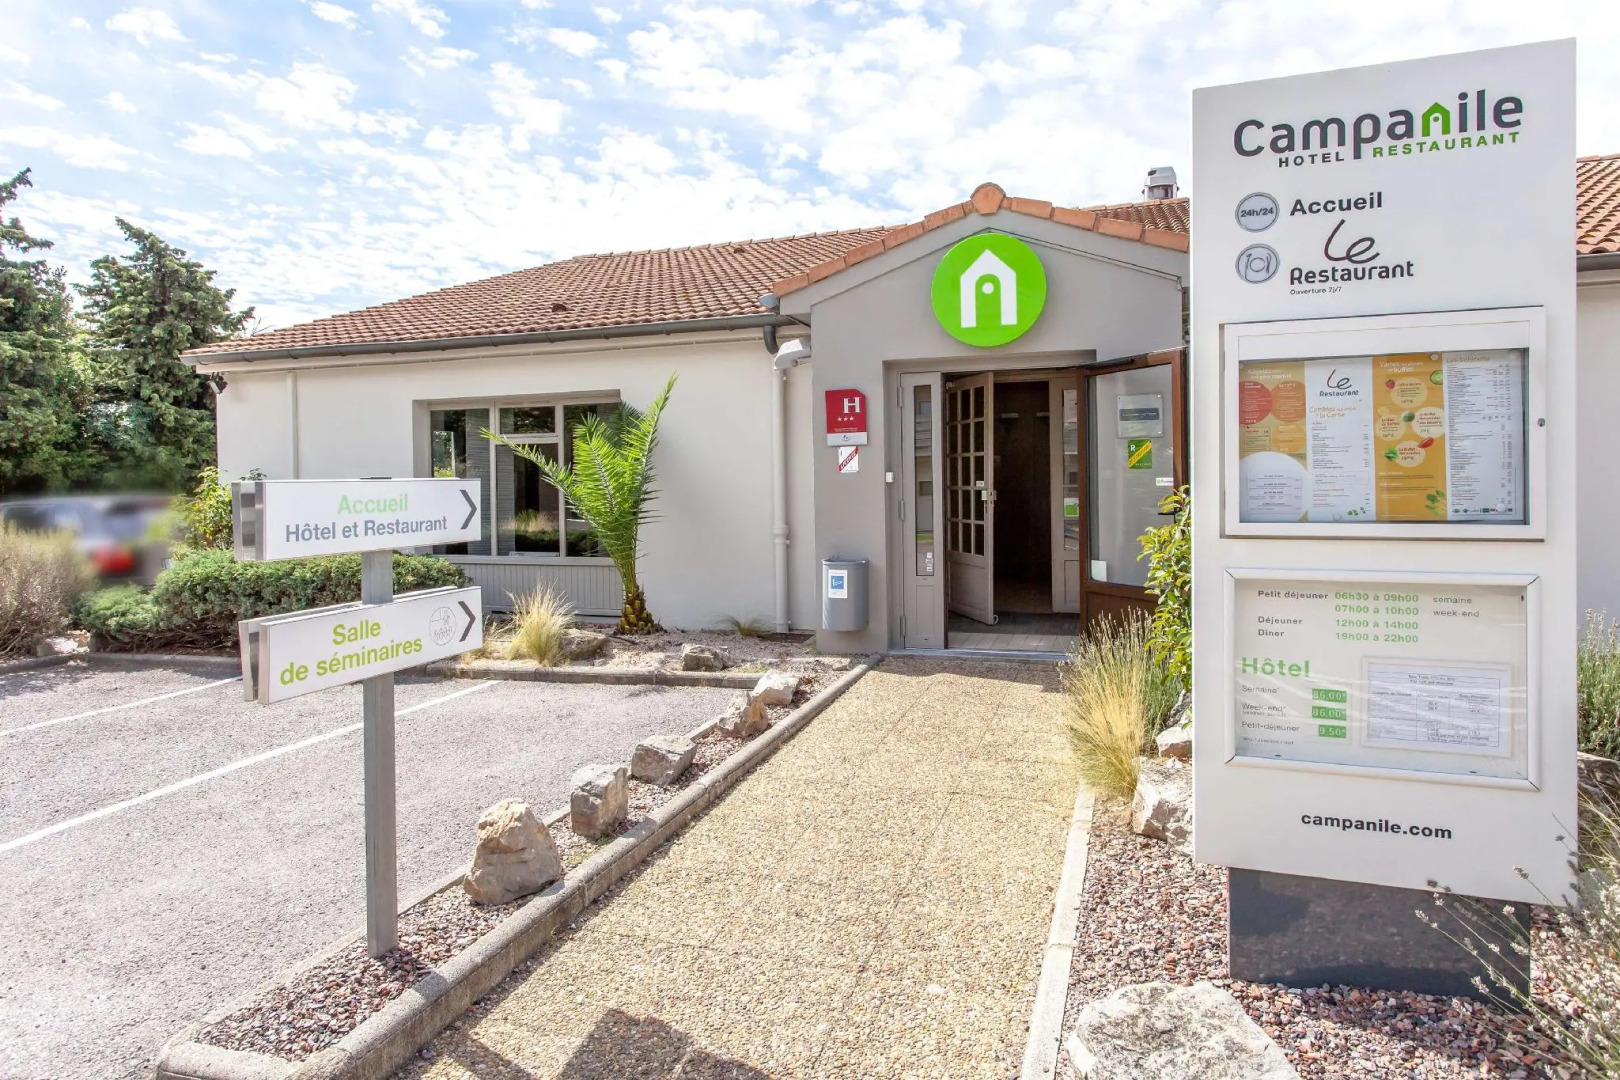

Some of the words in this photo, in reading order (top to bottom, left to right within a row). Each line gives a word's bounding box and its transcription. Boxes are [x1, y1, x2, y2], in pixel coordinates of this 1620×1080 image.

[1233, 89, 1523, 160] Campanile
[1278, 151, 1345, 168] HOTEL
[1373, 132, 1520, 158] RESTAURANT
[1240, 207, 1274, 217] 24h/24
[1290, 191, 1382, 216] Accueil
[1324, 219, 1380, 264] Le
[1290, 261, 1414, 285] Restaurant
[1327, 369, 1352, 389] Le
[843, 397, 861, 413] H
[337, 493, 408, 516] Accueil
[286, 521, 336, 543] Hôtel
[342, 521, 358, 539] et
[364, 516, 447, 537] Restaurant
[1258, 590, 1281, 598] Petit
[1284, 591, 1328, 599] déjeuner
[1335, 592, 1369, 600] 06h30
[1384, 593, 1419, 602] 09h00
[1335, 605, 1369, 613] 07h00
[1385, 606, 1419, 615] 10h00
[332, 619, 381, 646] Salle
[1258, 616, 1302, 624] Déjeuner
[1336, 619, 1369, 628] 12h00
[1385, 621, 1419, 630] 14h00
[1336, 632, 1369, 641] 19h00
[1384, 634, 1419, 643] 22h00
[280, 661, 308, 686] de
[316, 636, 423, 677] séminaires
[1242, 657, 1309, 677] Hôtel
[1242, 721, 1300, 732] Petit-déjeuner
[1301, 814, 1452, 839] campanile.com
